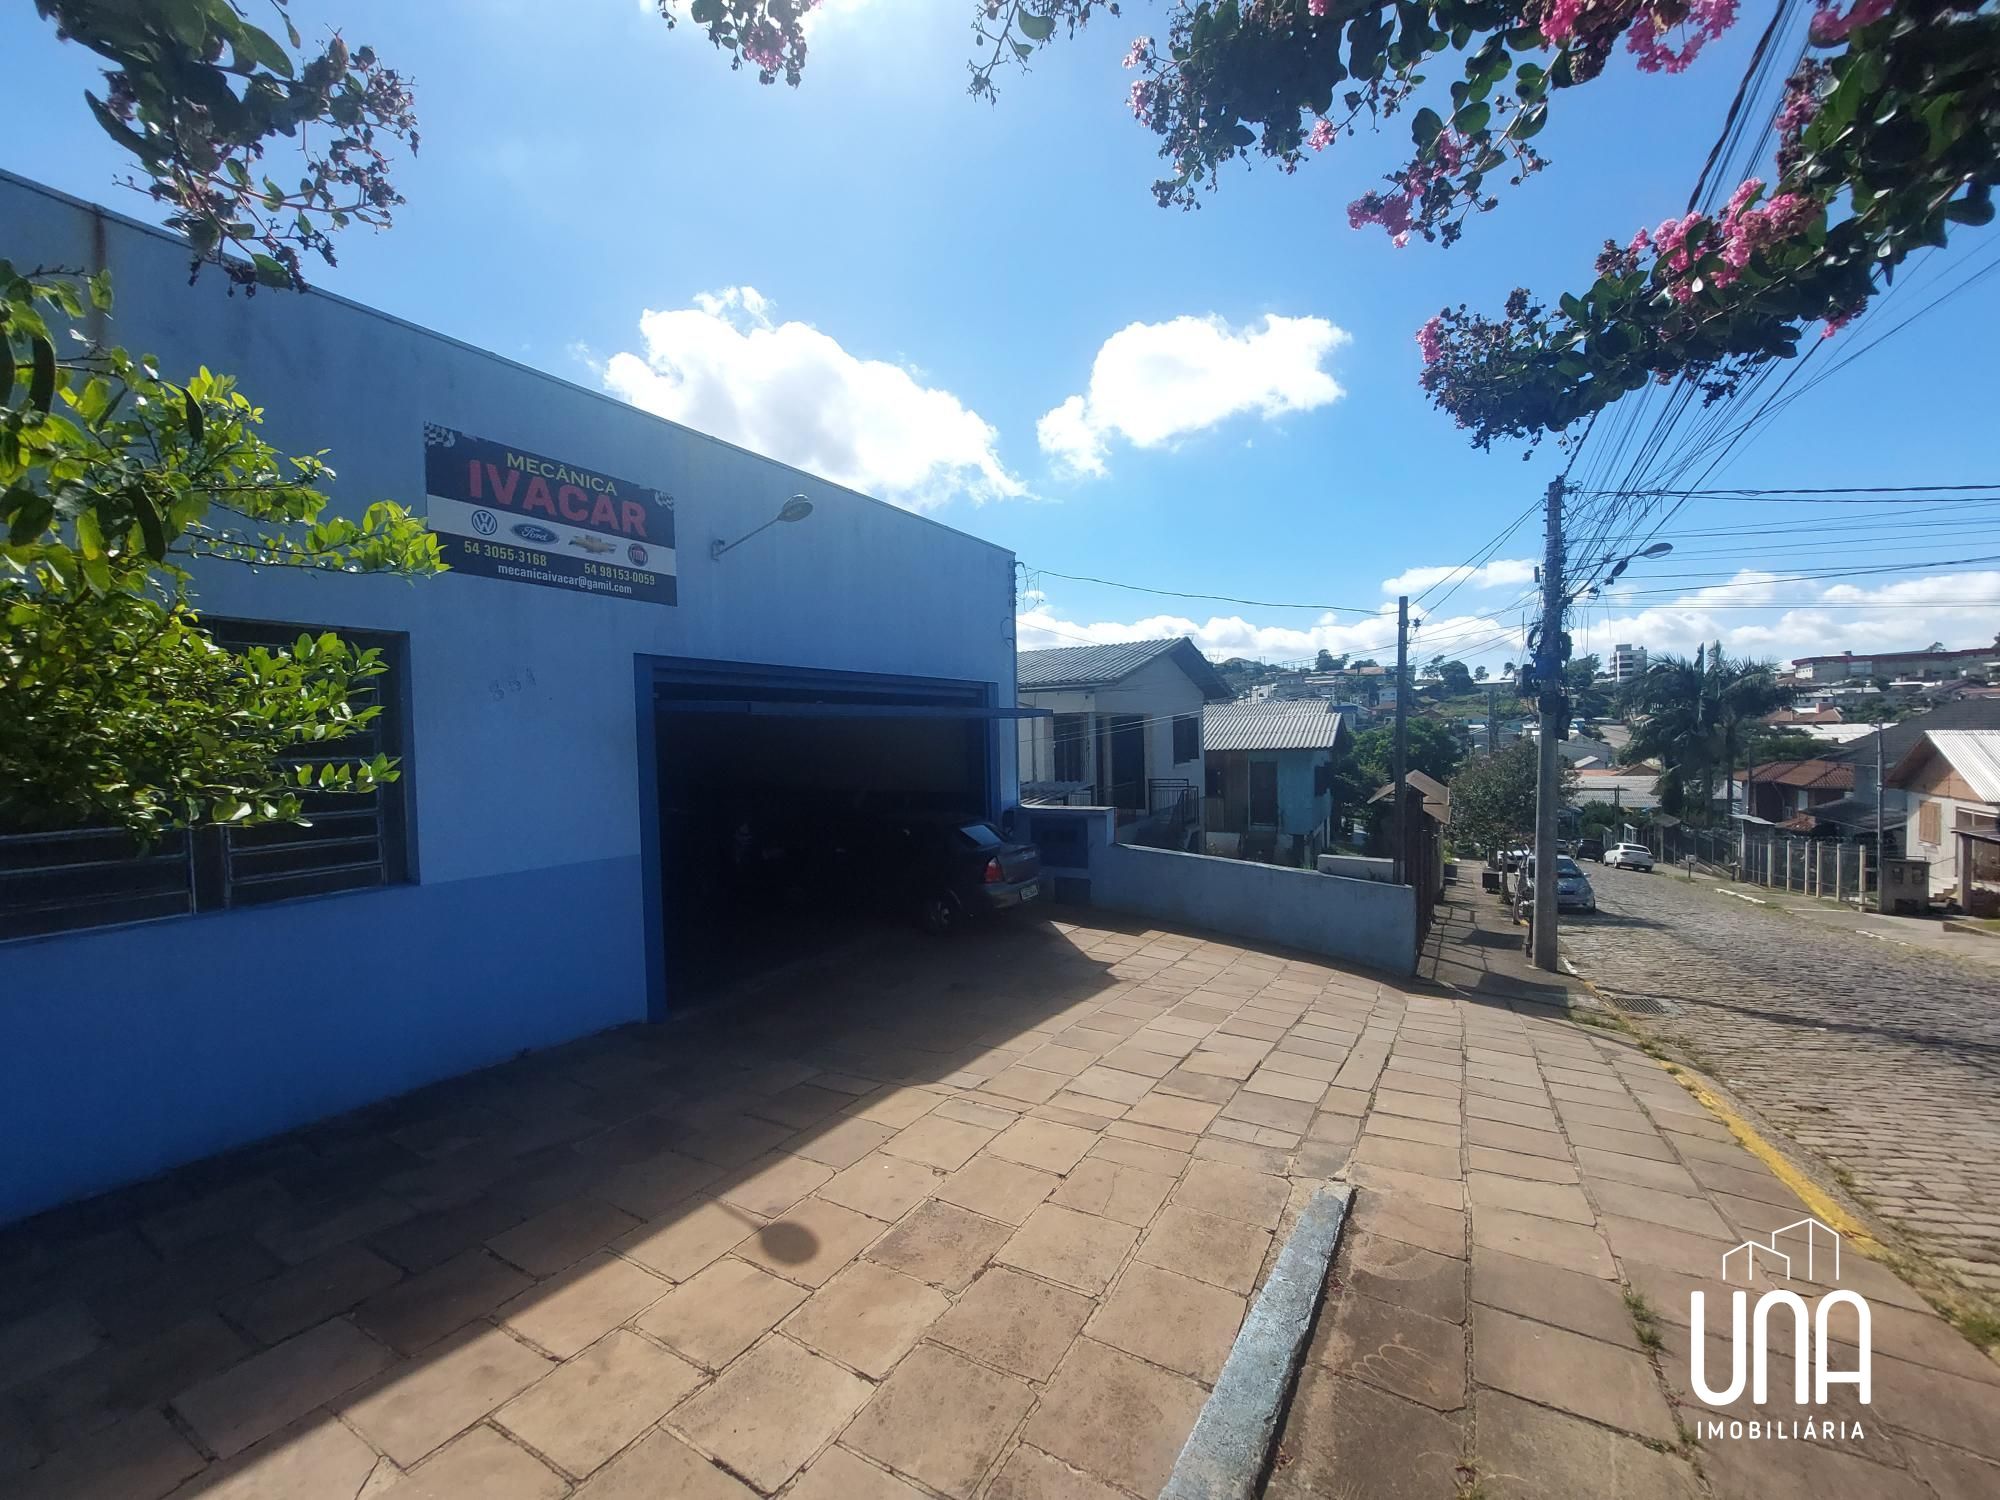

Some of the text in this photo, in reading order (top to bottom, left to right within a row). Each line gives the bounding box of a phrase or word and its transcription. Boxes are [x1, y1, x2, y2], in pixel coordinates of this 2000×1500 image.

[506, 452, 618, 496] MECÂNICA
[469, 460, 648, 537] IVACAR
[521, 526, 548, 541] Ford
[464, 540, 480, 555] 54
[498, 564, 632, 594] mecanicaivacar@gamil.com
[584, 563, 597, 576] 54
